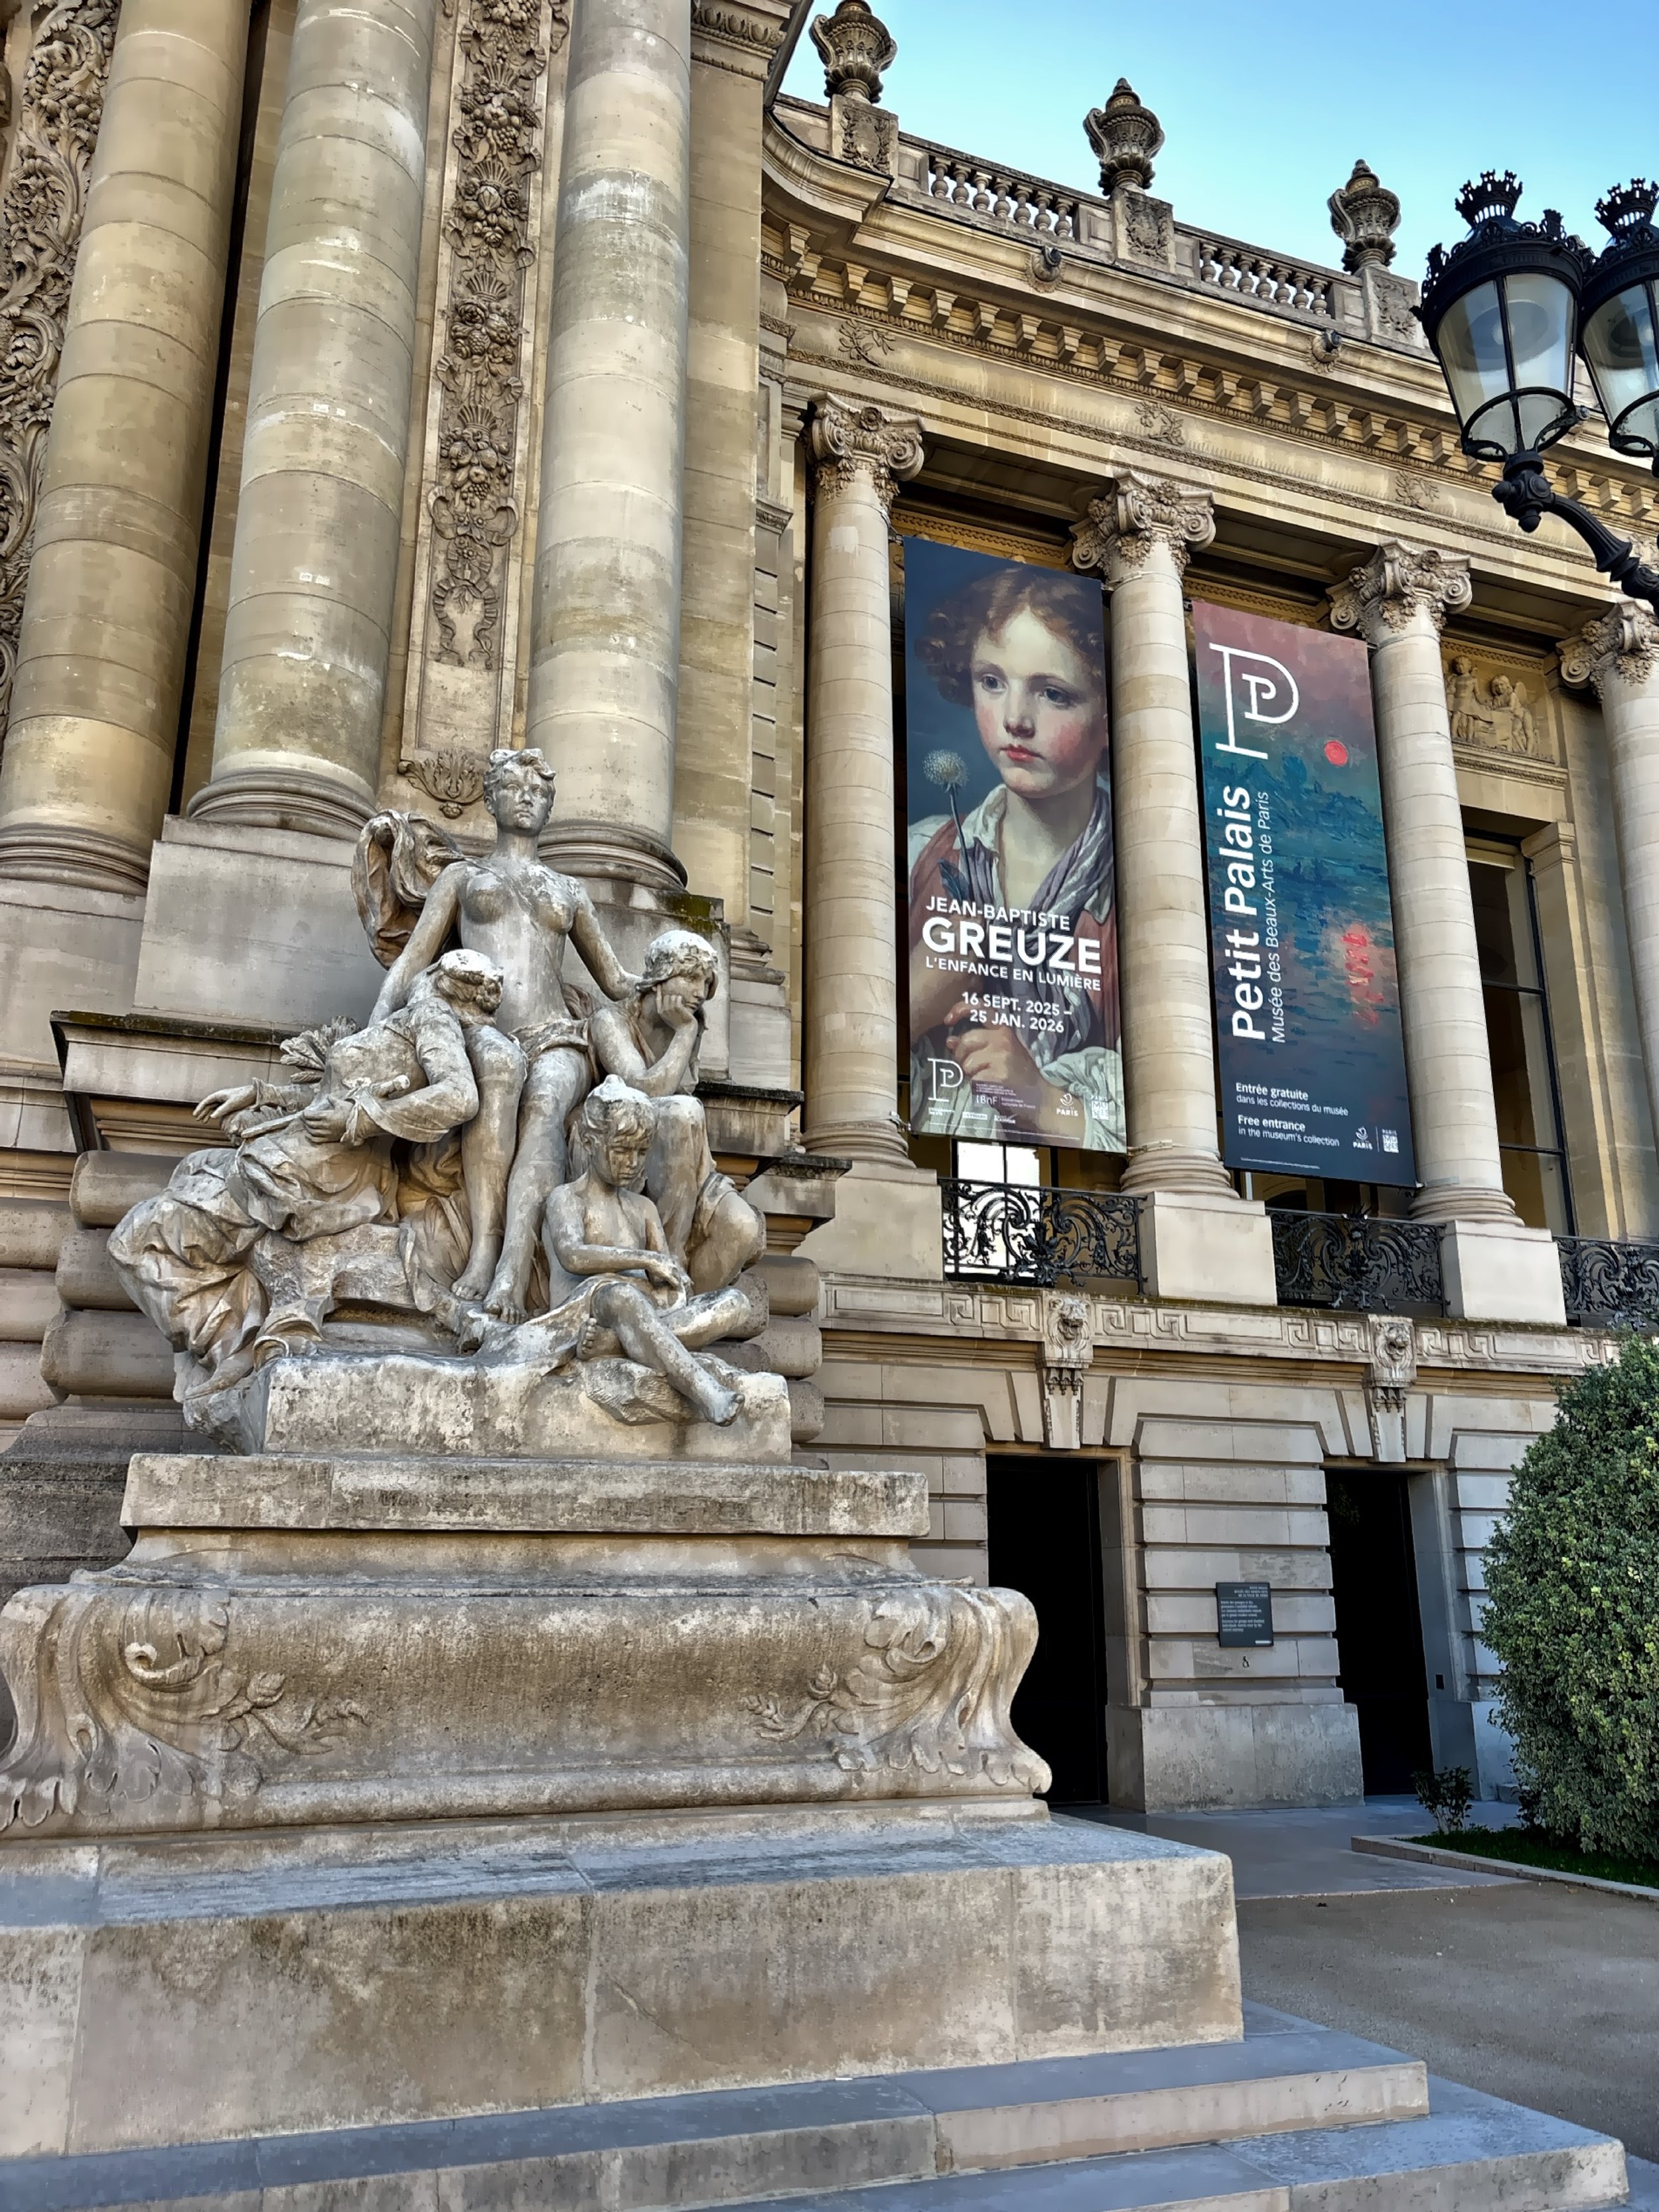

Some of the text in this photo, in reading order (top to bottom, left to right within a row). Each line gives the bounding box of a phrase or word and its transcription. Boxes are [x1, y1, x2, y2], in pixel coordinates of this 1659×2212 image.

[926, 896, 1070, 932] JEAN-BAPTISTE
[1217, 786, 1265, 1040] Petit Palais
[1256, 792, 1285, 1043] Musée des Beaux-Arts de Paris
[922, 916, 1102, 975] GREUZE
[926, 956, 1101, 991] L'ENFANCE EN LUMIÈRE
[962, 991, 979, 1006] 16
[983, 994, 1021, 1012] SEPT.
[1026, 1001, 1060, 1016] 2025
[970, 1009, 1064, 1033] 25 JAN. 2026
[1236, 1082, 1309, 1101] Entrée gratuite
[1056, 1108, 1078, 1117] PARIS
[1236, 1094, 1349, 1116] dans les collections du musée
[1238, 1115, 1306, 1133] Free entrance
[1238, 1126, 1340, 1147] in the museum's collection
[1352, 1141, 1373, 1150] PARIS
